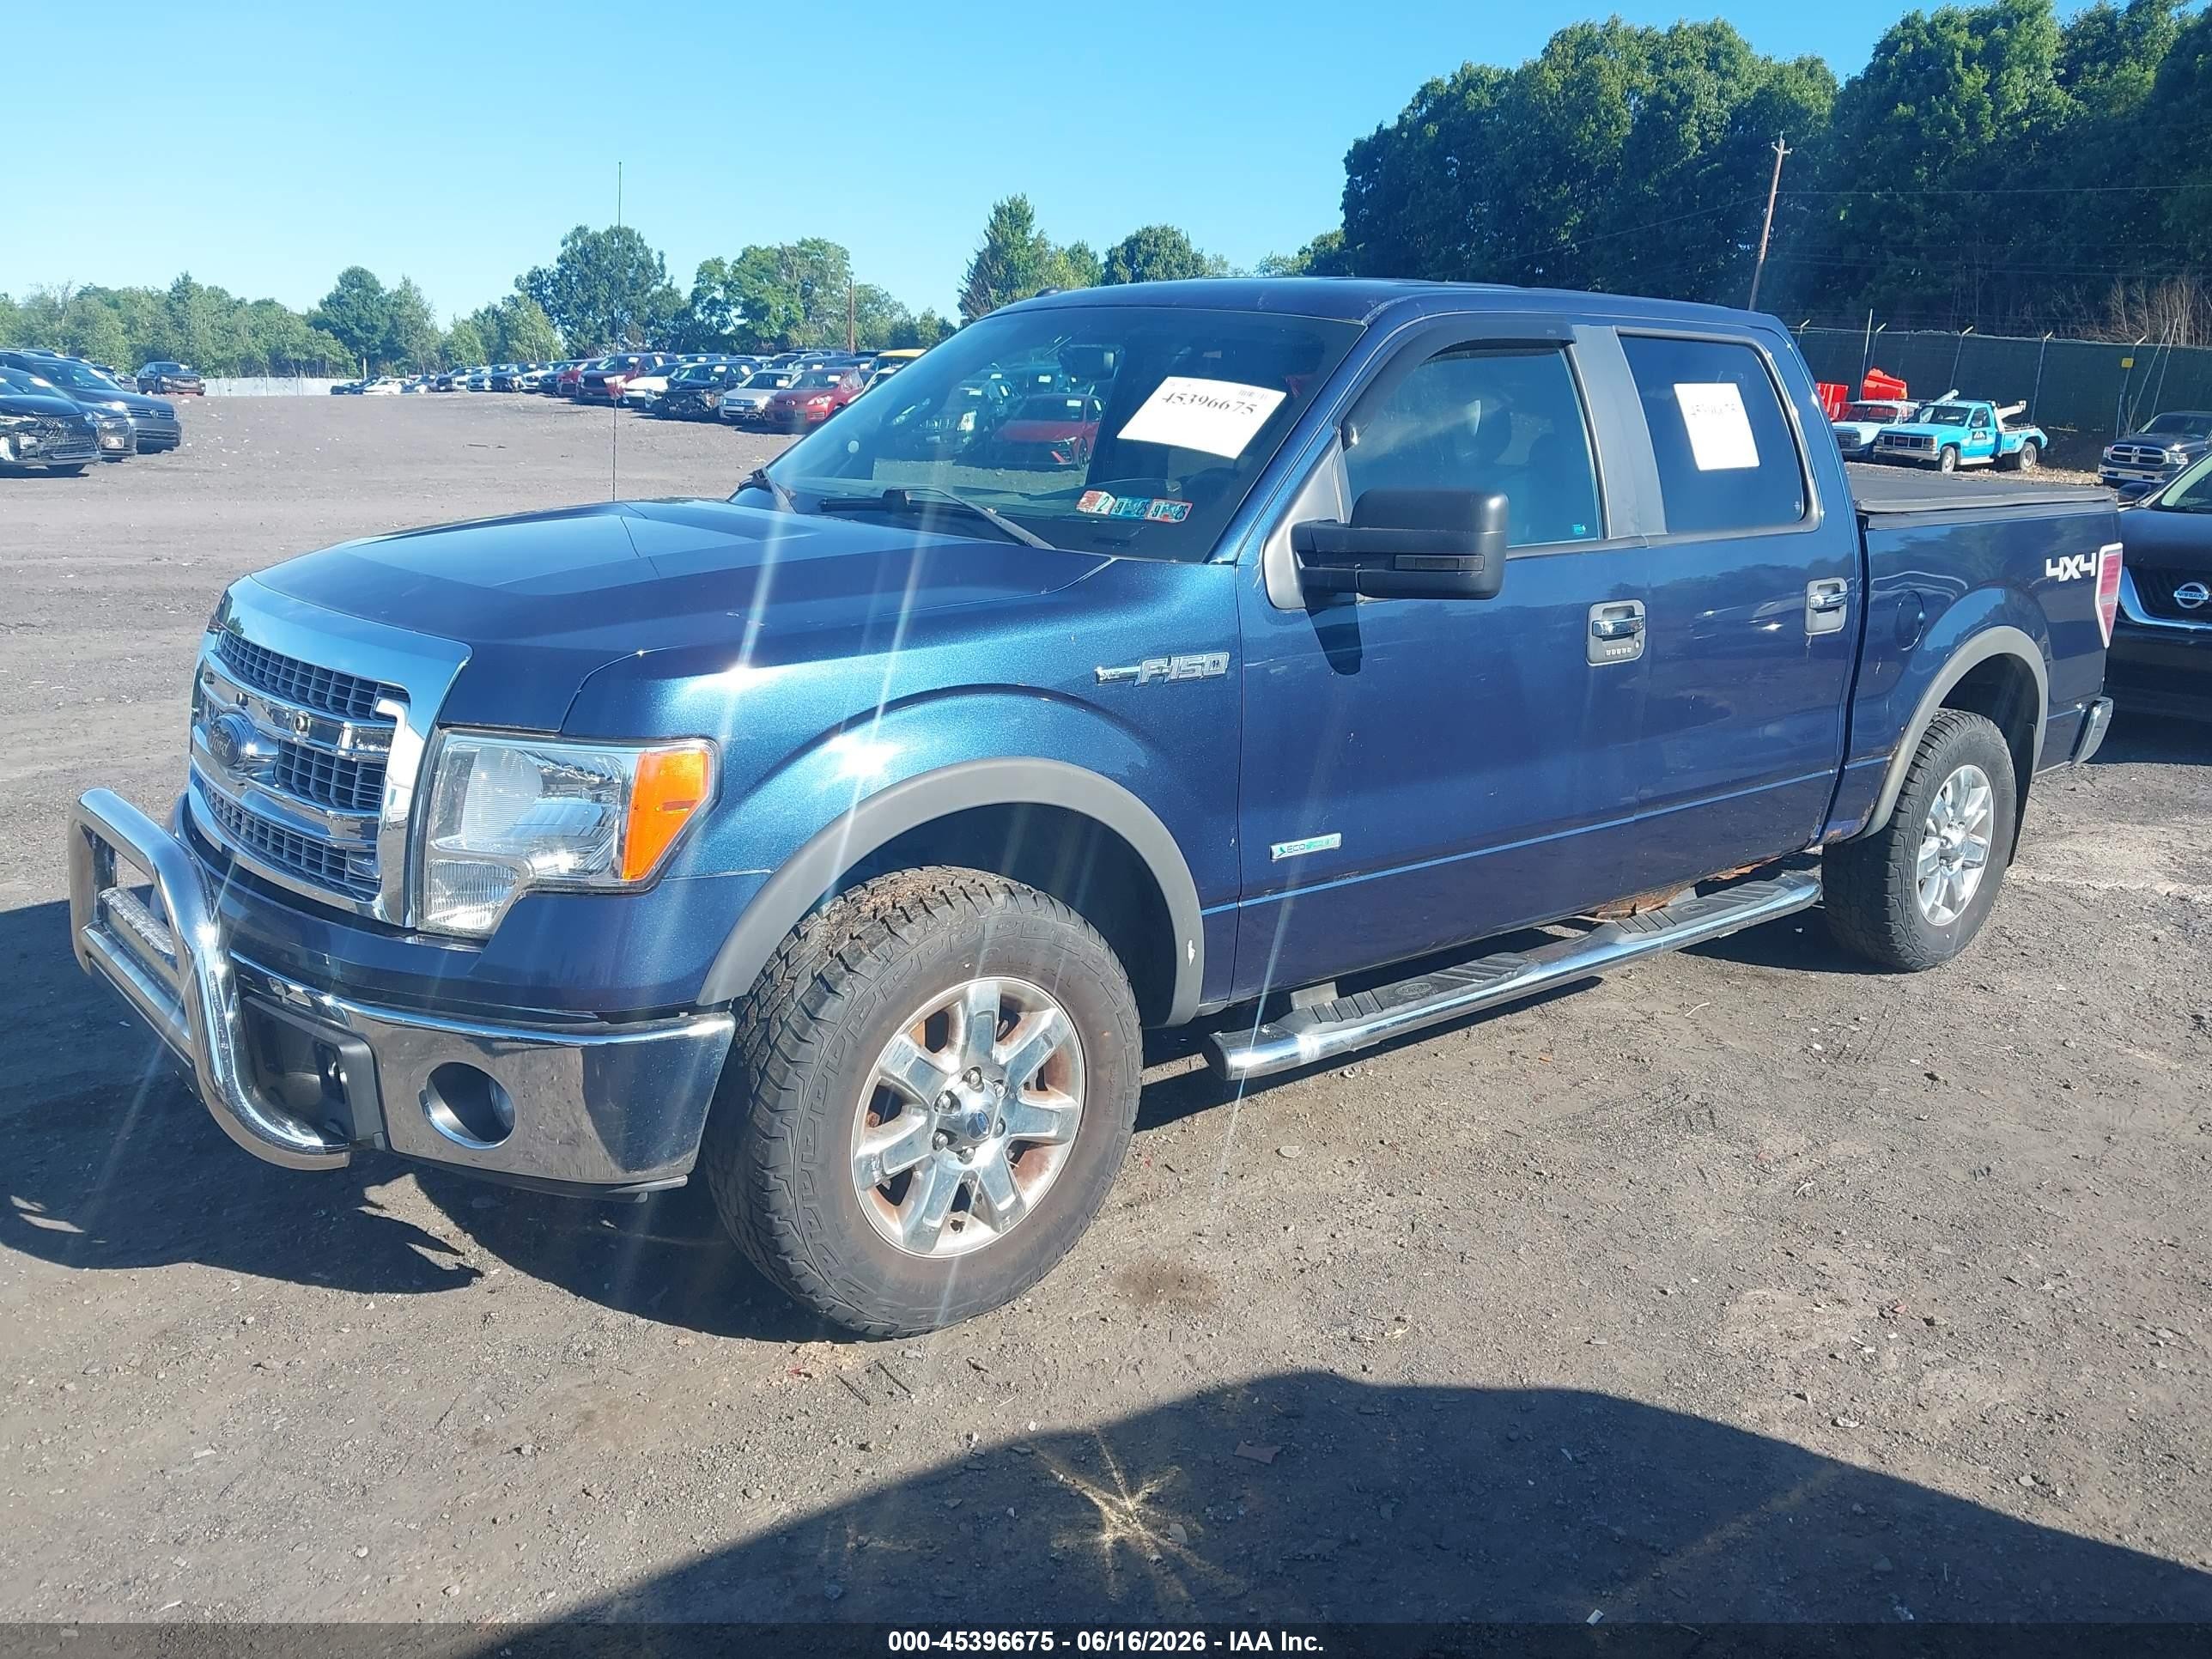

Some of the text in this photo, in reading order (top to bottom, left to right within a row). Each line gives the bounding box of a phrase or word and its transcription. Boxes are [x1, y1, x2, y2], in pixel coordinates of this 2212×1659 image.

[1162, 392, 1258, 415] 45396675
[2175, 591, 2206, 599] NISSAN
[209, 732, 231, 757] Ford
